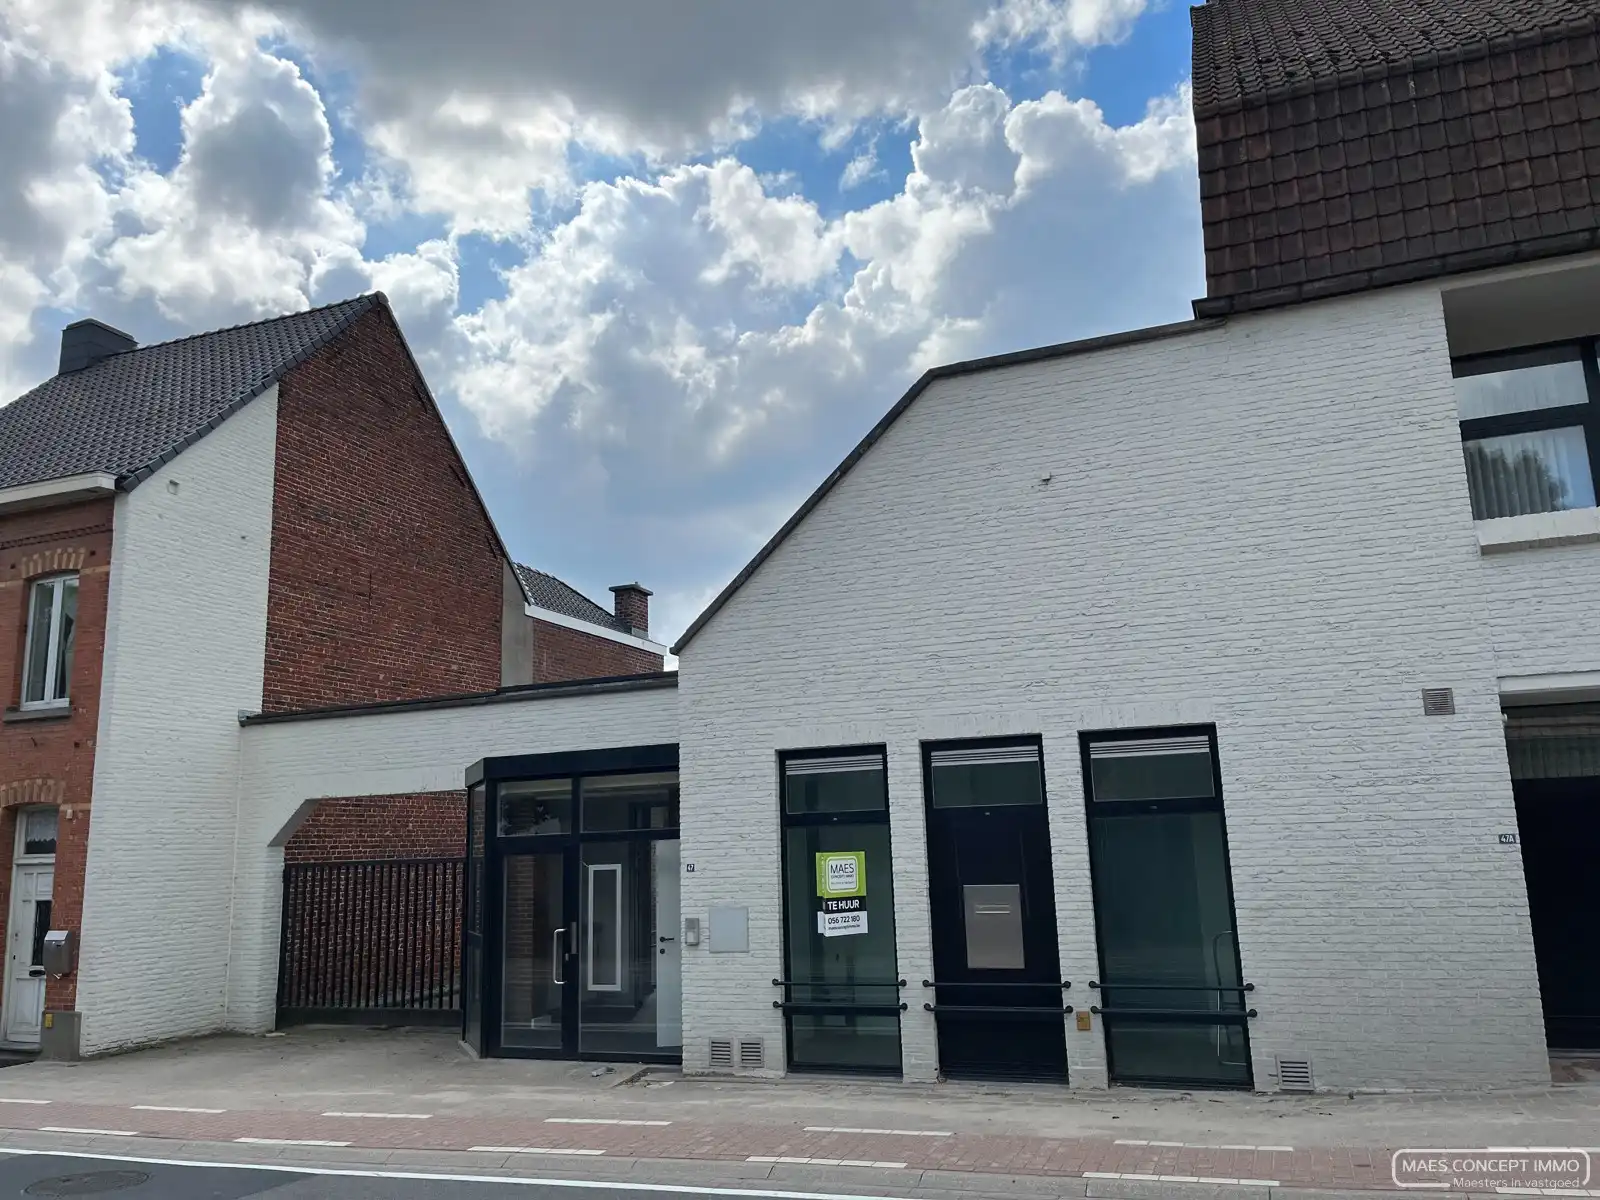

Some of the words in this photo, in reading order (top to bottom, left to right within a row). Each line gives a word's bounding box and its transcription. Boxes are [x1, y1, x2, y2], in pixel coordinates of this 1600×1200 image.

[1500, 834, 1515, 843] 47A
[830, 863, 855, 874] MAES
[827, 901, 838, 910] TE
[838, 899, 860, 909] HUUR
[827, 917, 840, 925] 056
[840, 915, 850, 923] 722
[850, 914, 861, 922] 180
